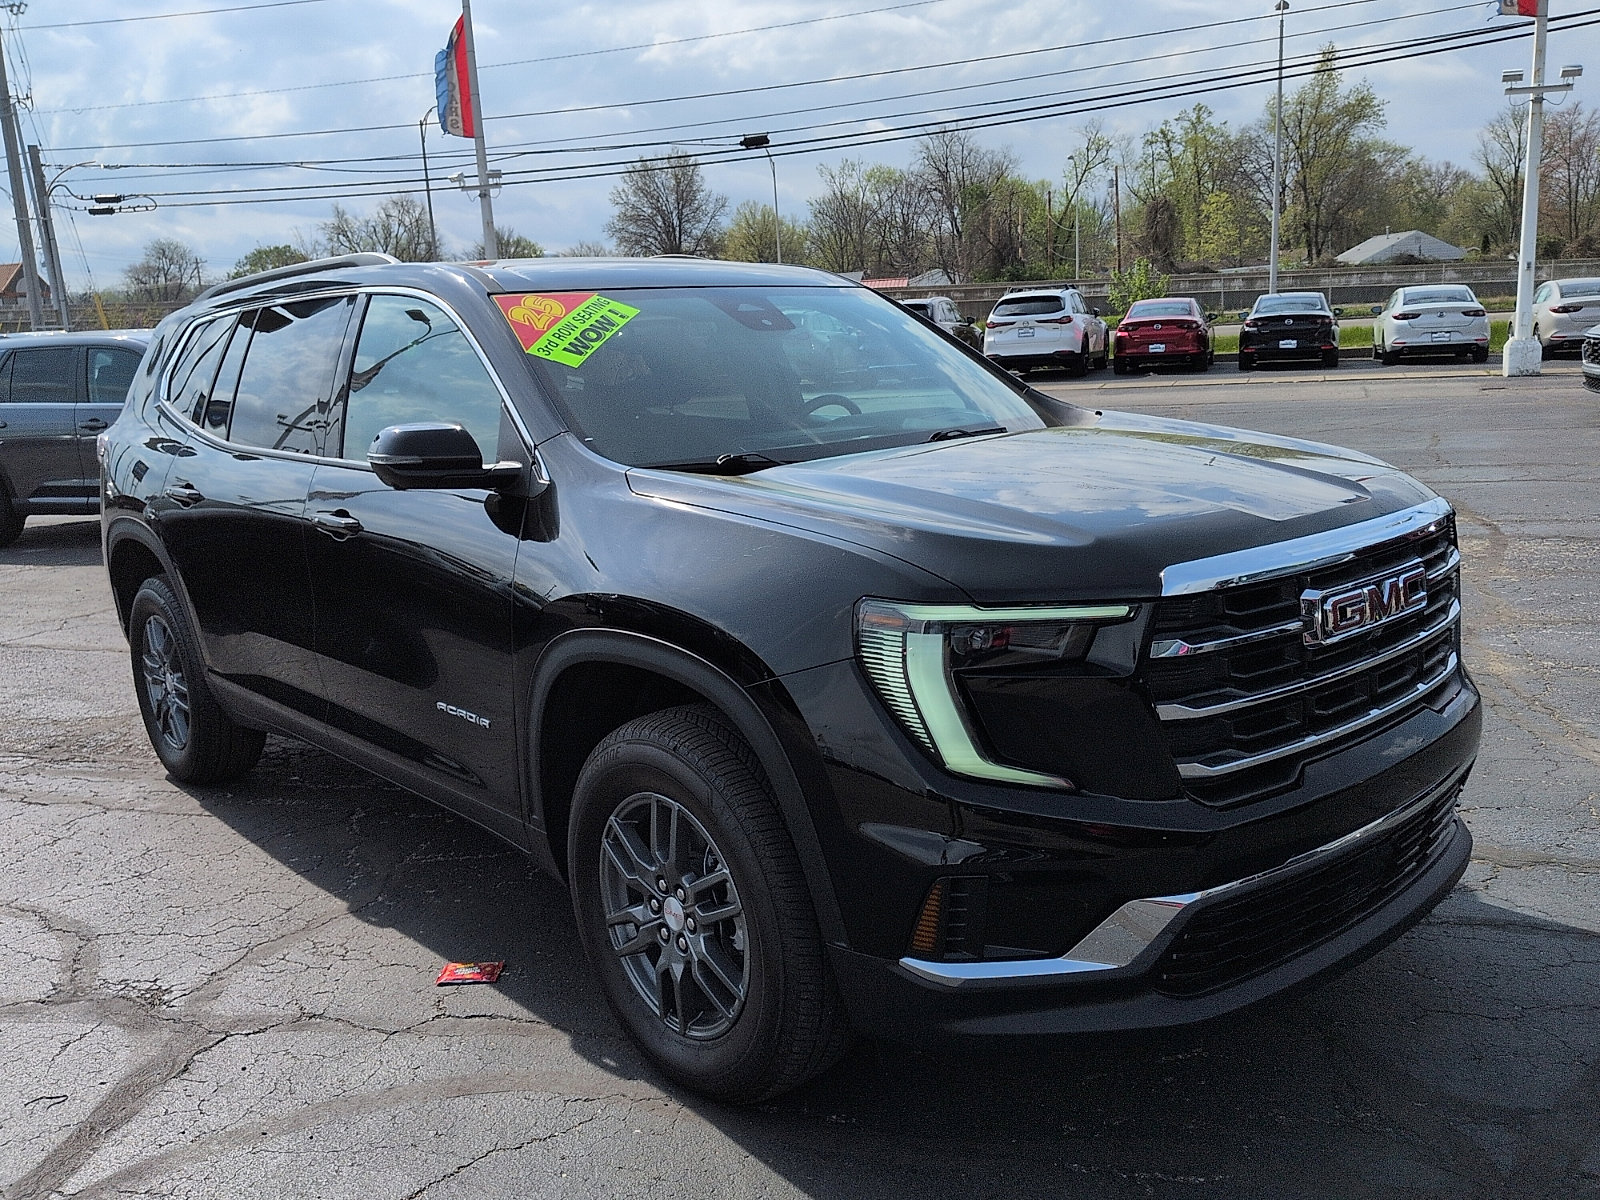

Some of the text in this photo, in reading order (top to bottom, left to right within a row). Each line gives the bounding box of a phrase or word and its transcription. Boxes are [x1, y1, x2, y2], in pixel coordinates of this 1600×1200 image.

[508, 295, 566, 331] 25
[536, 297, 610, 356] 3rd ROW SEATING
[1323, 567, 1428, 634] GMC
[436, 701, 491, 729] ACADIA
